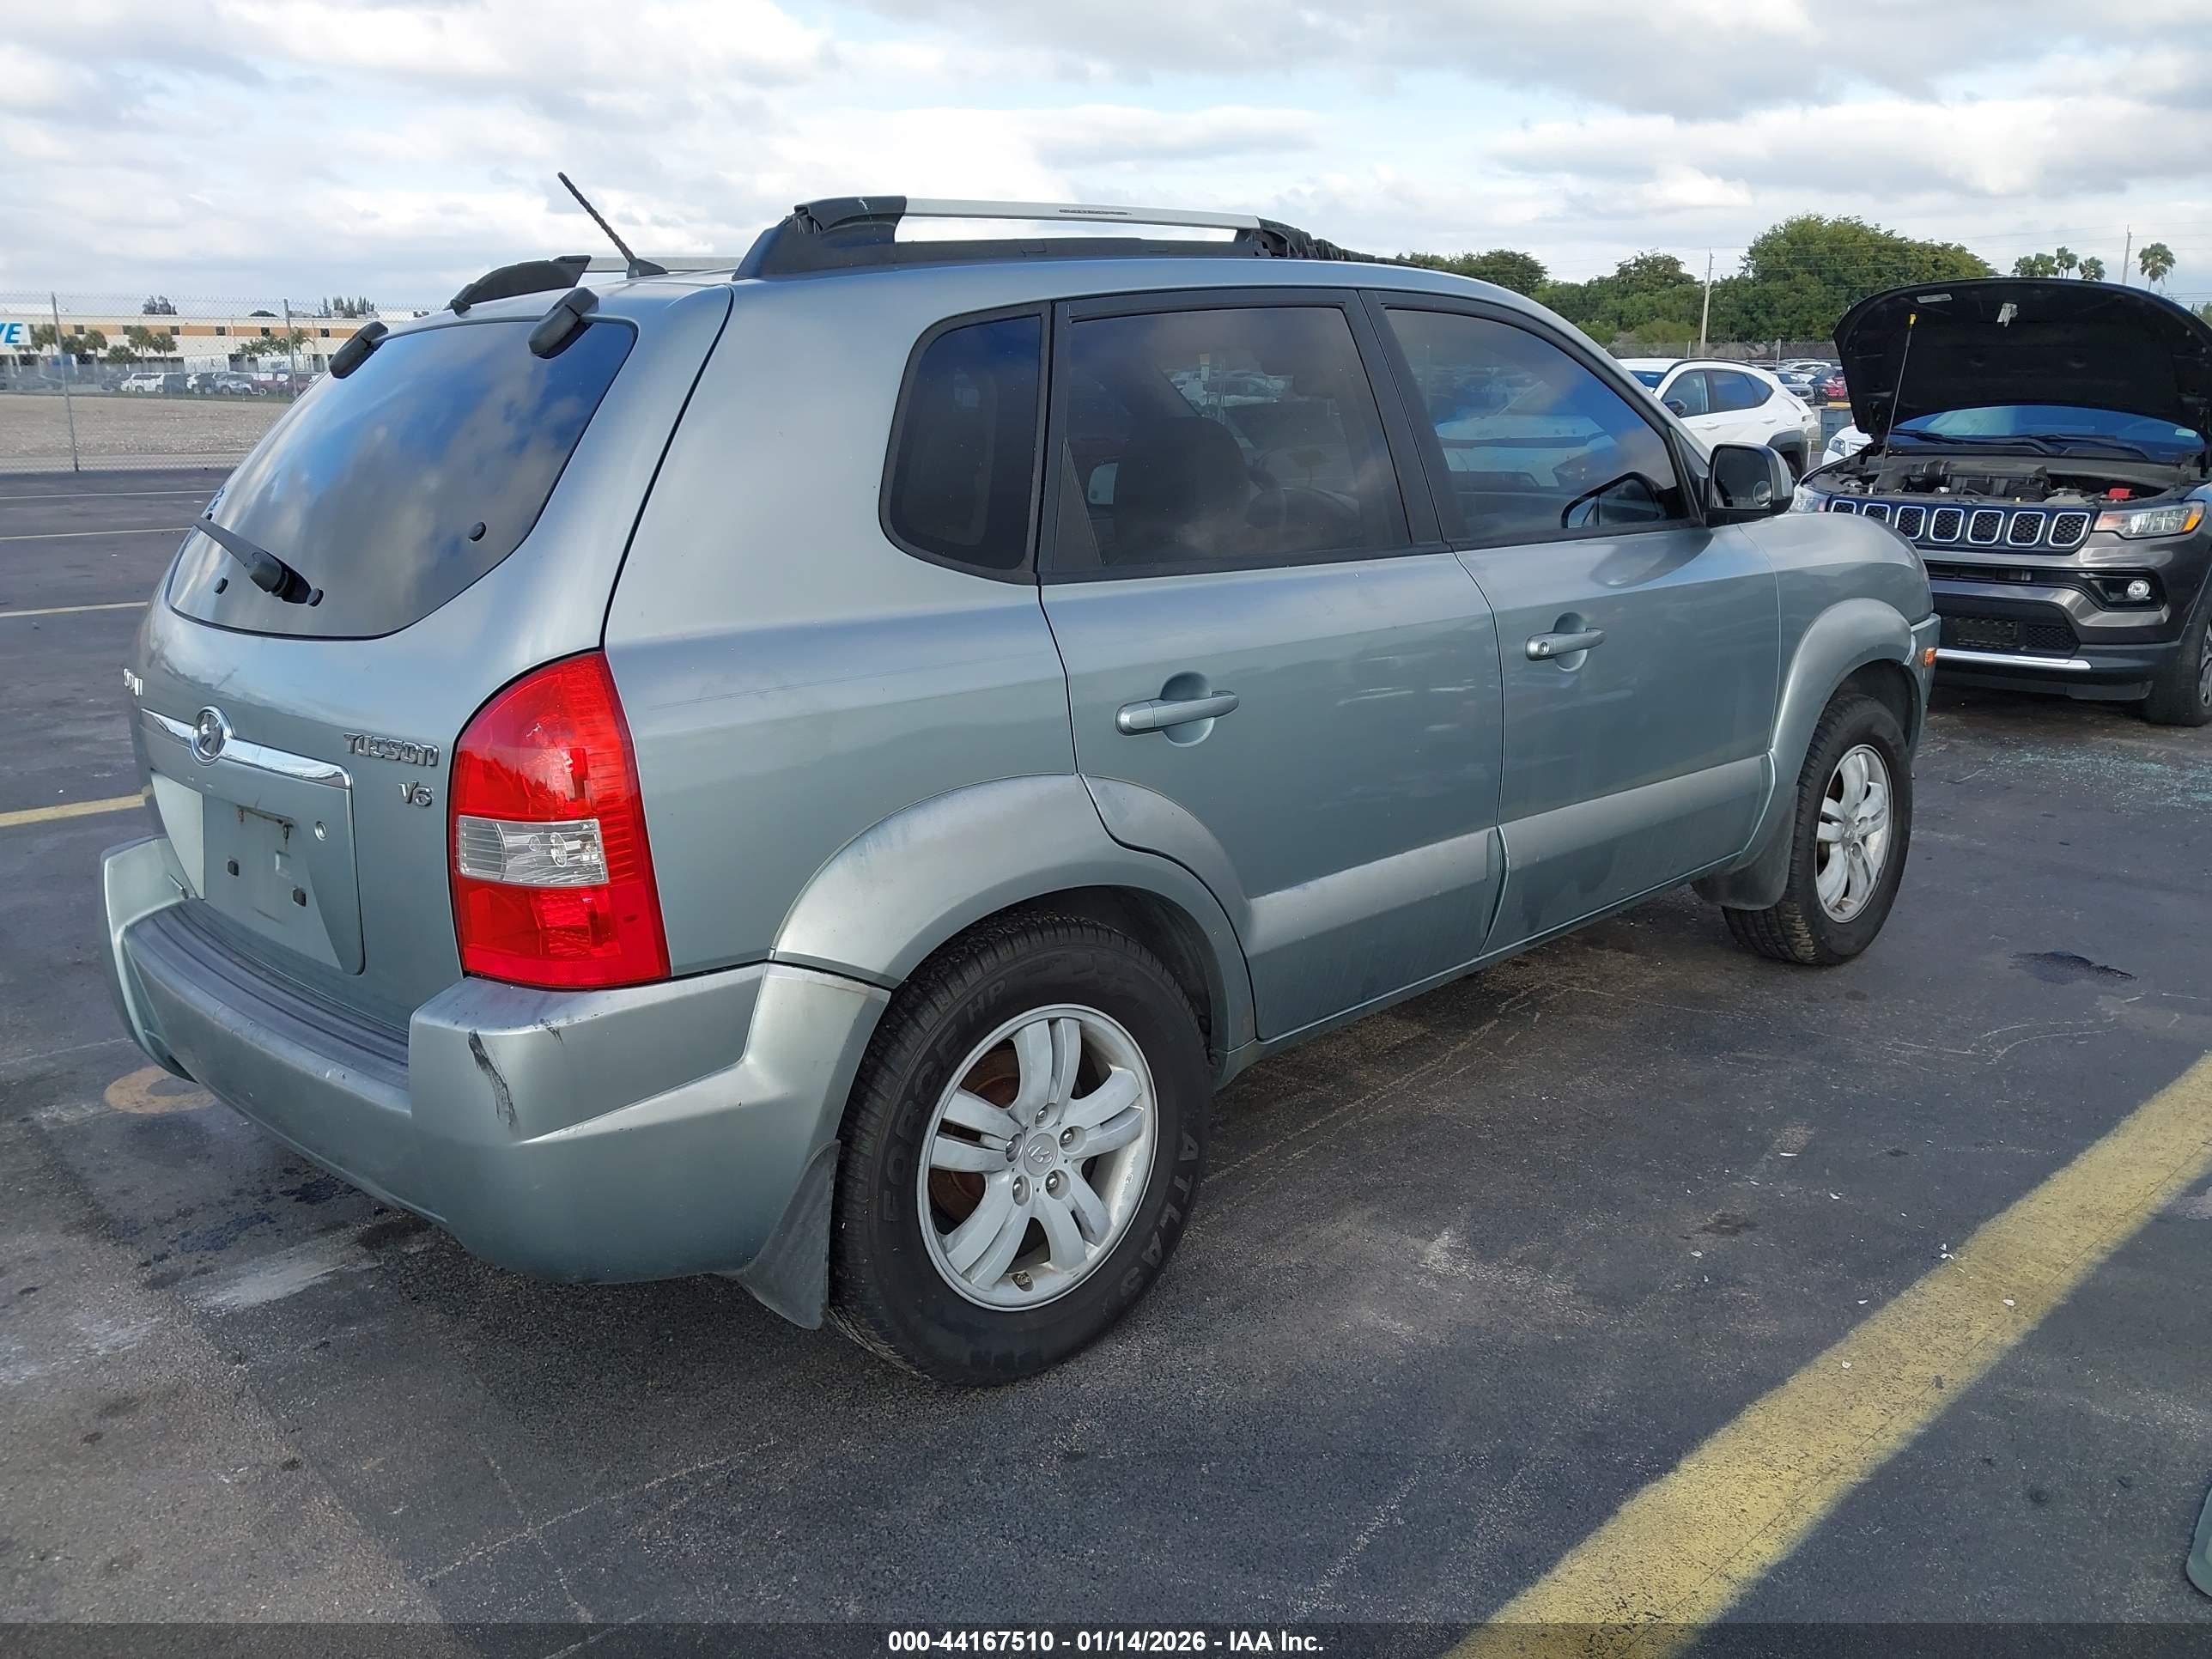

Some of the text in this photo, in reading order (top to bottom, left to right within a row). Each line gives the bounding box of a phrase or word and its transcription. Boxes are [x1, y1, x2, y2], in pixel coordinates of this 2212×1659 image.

[343, 732, 441, 767] TUCSON
[398, 779, 434, 807] V6
[966, 979, 1007, 1023] HP
[1121, 1131, 1200, 1297] ATLAS
